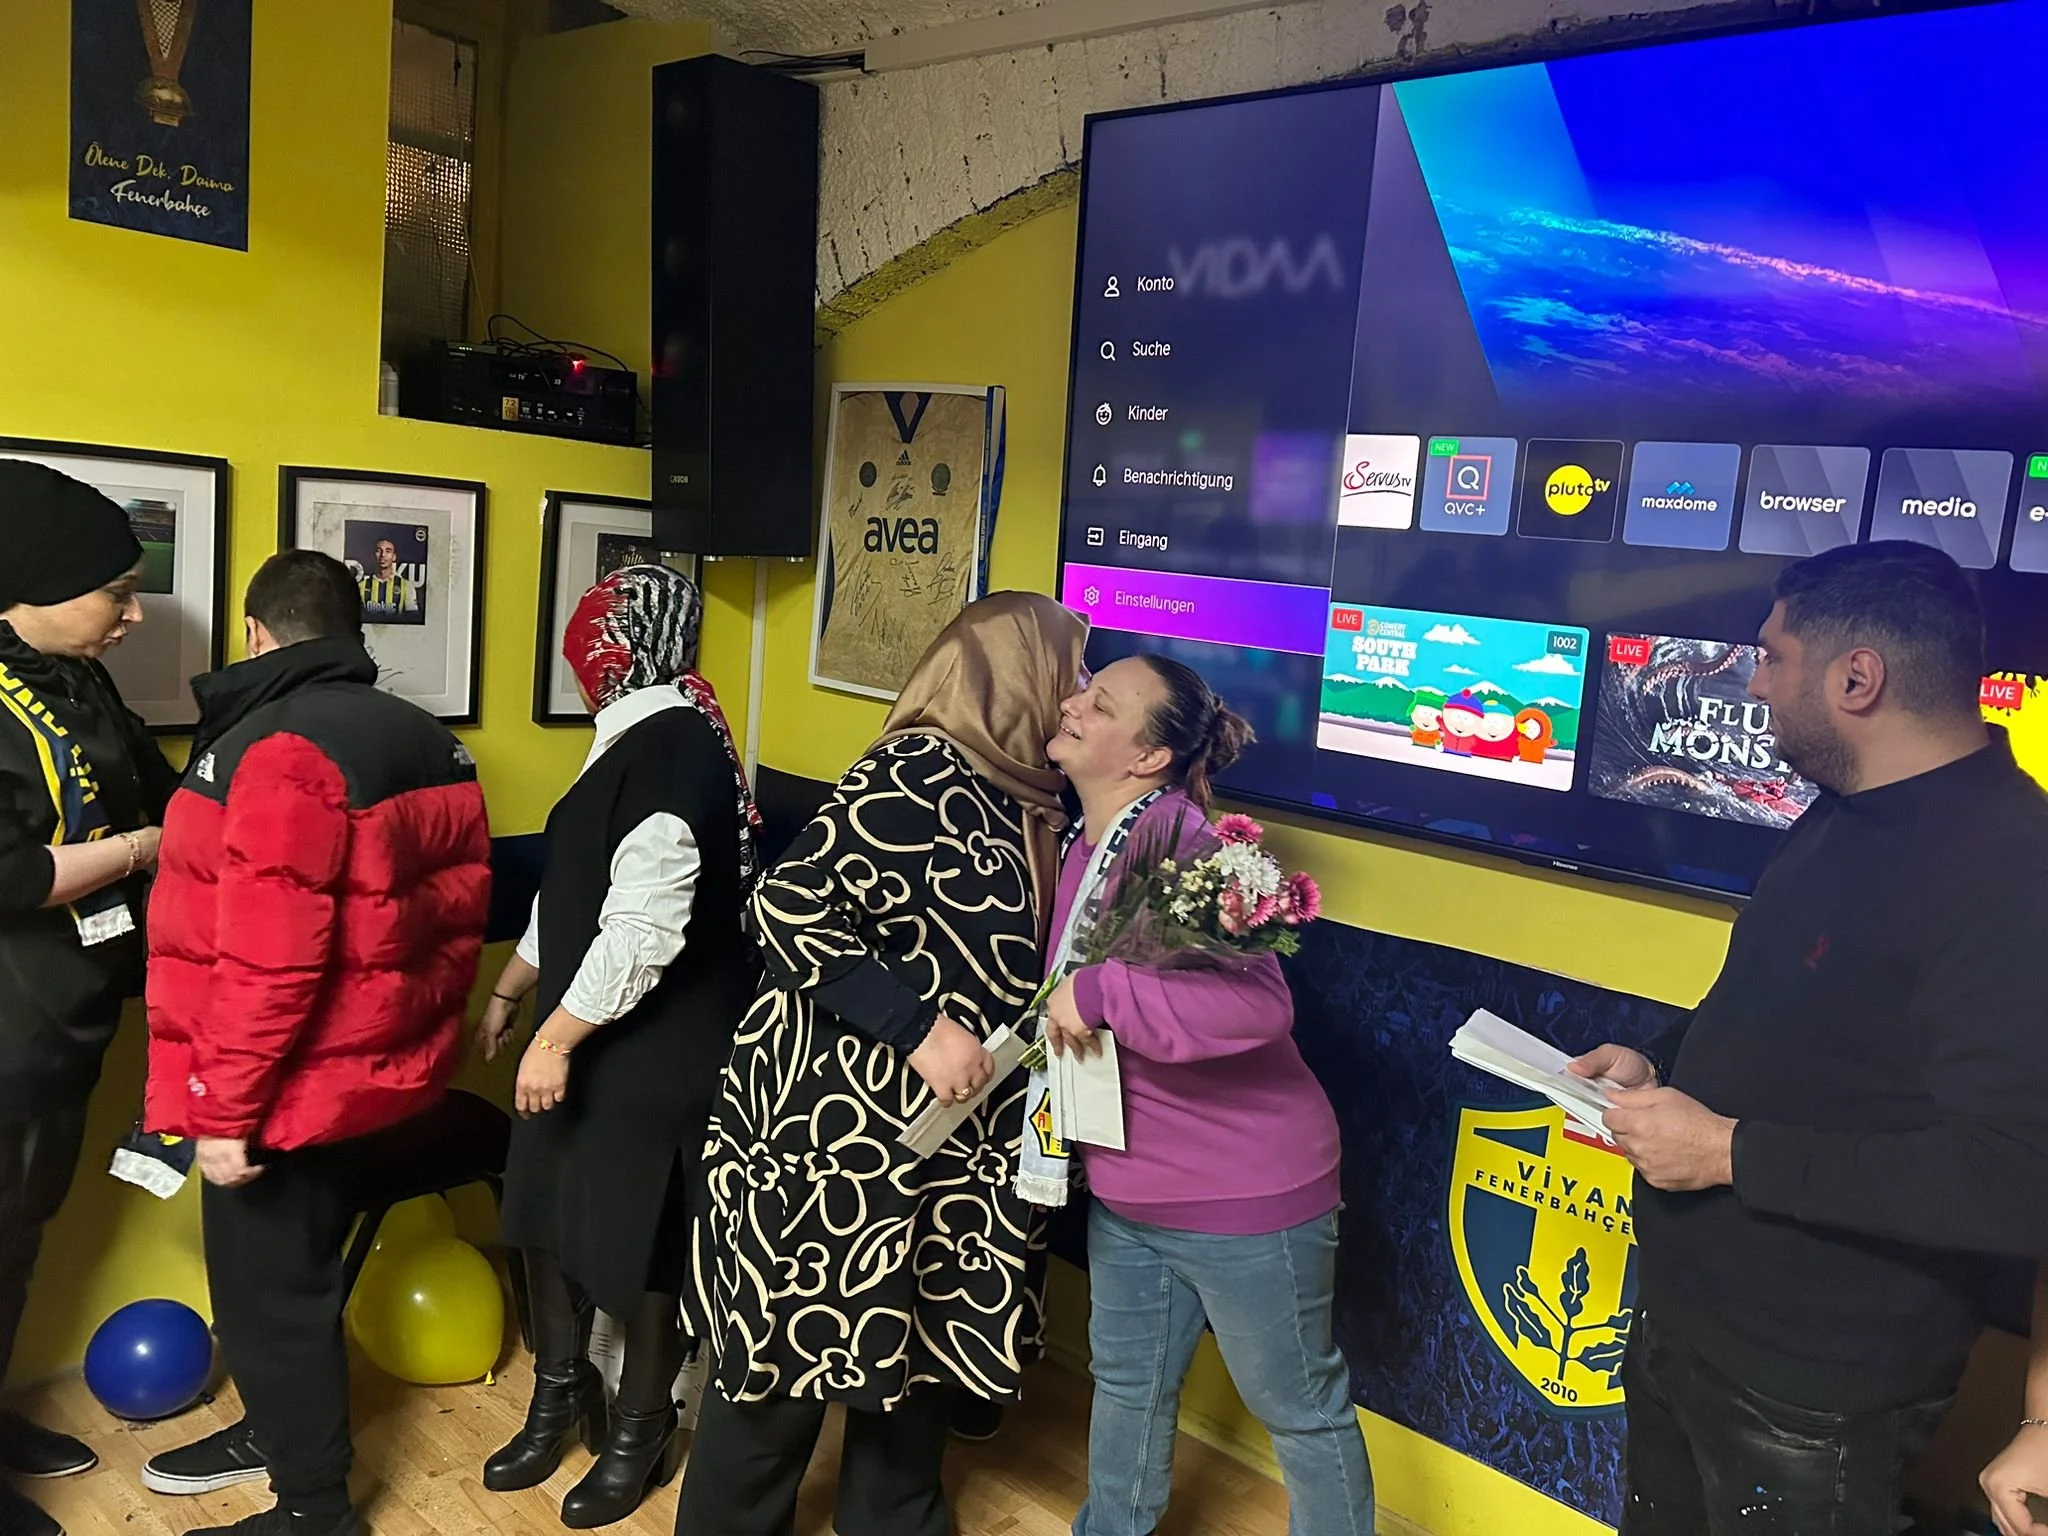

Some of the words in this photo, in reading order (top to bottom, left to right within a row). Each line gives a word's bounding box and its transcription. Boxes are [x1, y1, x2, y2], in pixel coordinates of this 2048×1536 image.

[85, 141, 129, 170] Ölene
[181, 165, 234, 192] Daima
[110, 179, 211, 218] Fenerbahçe
[1137, 275, 1174, 292] Konto
[1132, 340, 1171, 357] Suche
[1128, 405, 1168, 421] Kinder
[1434, 443, 1455, 452] NEW
[1123, 468, 1234, 491] Benachrichtigung
[1457, 466, 1480, 490] Q
[1594, 478, 1611, 492] tv
[1548, 482, 1594, 498] pluto
[1444, 502, 1486, 516] QVC+
[1641, 496, 1718, 512] maxdome
[1759, 491, 1847, 513] browser
[1901, 496, 1978, 518] media
[863, 516, 939, 555] avea
[1119, 530, 1168, 551] Eingang
[1115, 590, 1195, 614] Einstellungen
[1336, 613, 1359, 625] LIVE
[1380, 621, 1406, 631] COMEDY
[1380, 629, 1406, 639] CENTRAL
[1552, 635, 1578, 651] 1002
[1351, 635, 1418, 660] SOUTH
[1616, 643, 1643, 657] LIVE
[1355, 654, 1411, 677] PARK
[1980, 683, 2016, 701] LIVE
[1647, 721, 1791, 774] MONS
[1474, 1169, 1631, 1236] FENERBAHÇE
[1540, 1377, 1578, 1403] 2010
